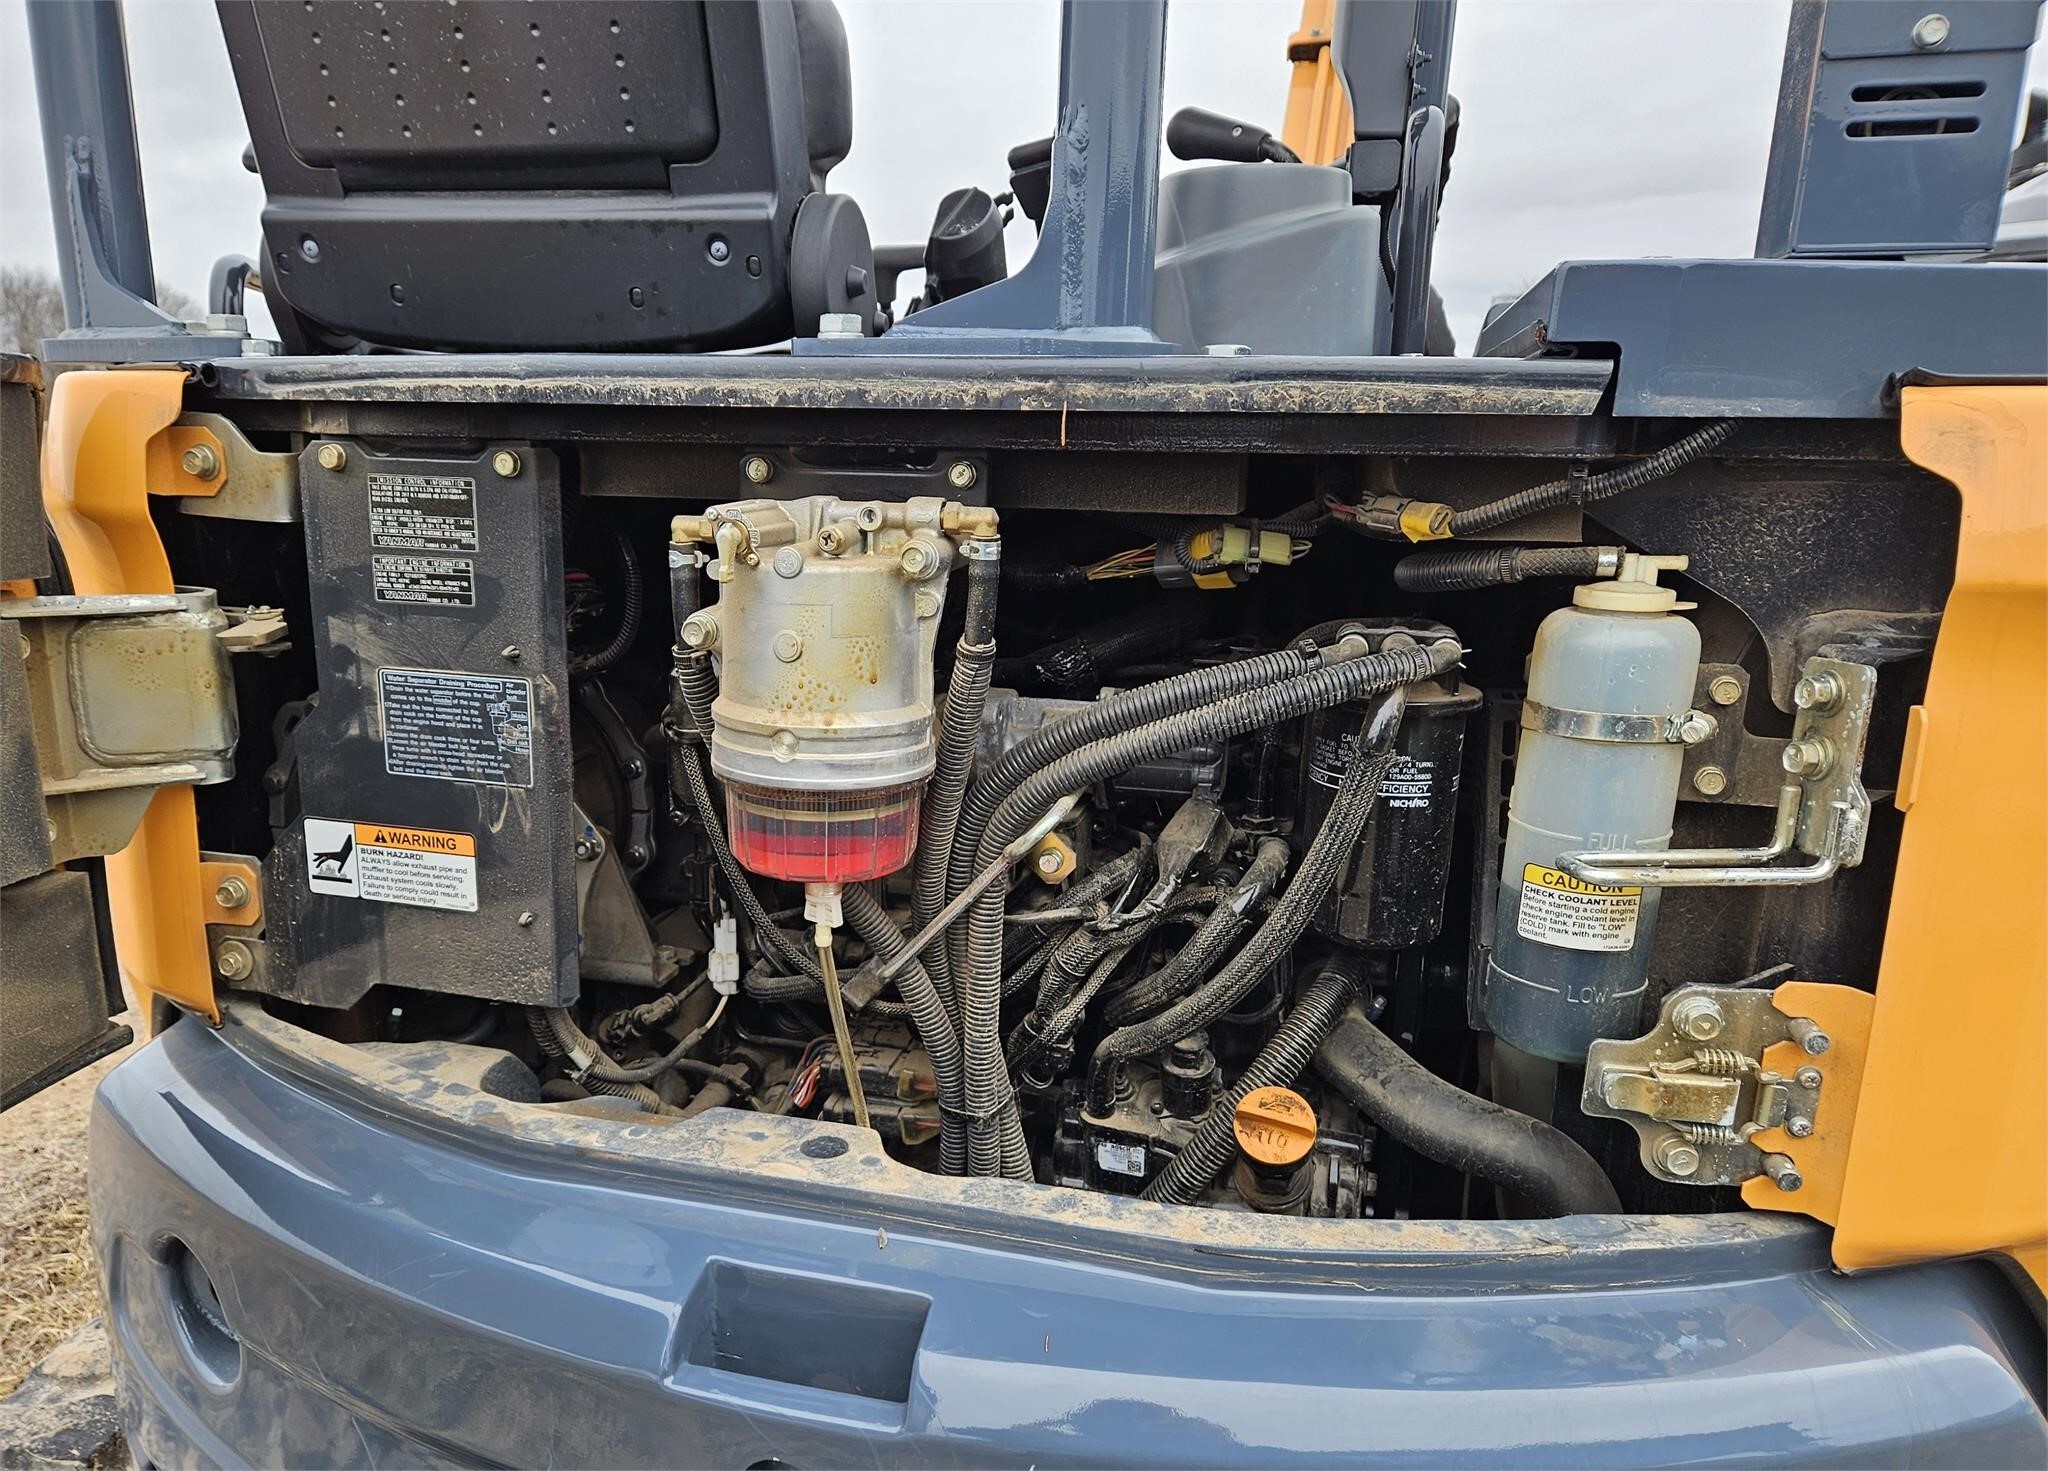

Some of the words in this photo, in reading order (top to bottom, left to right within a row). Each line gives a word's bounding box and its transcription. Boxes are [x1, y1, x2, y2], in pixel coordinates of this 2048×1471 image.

[378, 476, 402, 484] EMISSION
[404, 477, 426, 486] CONTROL
[430, 479, 464, 487] INFORMATION
[378, 535, 424, 547] YANMAR
[383, 590, 427, 600] YANMAR
[387, 675, 405, 683] Water
[407, 676, 437, 686] Separator
[439, 679, 465, 688] Draining
[467, 681, 499, 690] Procedure
[1341, 733, 1360, 743] CAUT
[1337, 749, 1353, 757] BEFO
[1389, 798, 1429, 808] NICHIRO
[388, 831, 456, 850] WARNING
[1590, 832, 1629, 850] FULL
[361, 848, 384, 857] BURN
[387, 851, 423, 860] HAZARD!
[361, 856, 391, 865] ALWAYS
[393, 860, 409, 868] allow
[411, 862, 437, 871] exhaust
[362, 865, 385, 873] muffler
[410, 871, 430, 879] before
[432, 874, 463, 883] servicing.
[362, 873, 388, 882] Exhaust
[391, 877, 414, 885] system
[435, 882, 458, 891] slowly.
[363, 882, 385, 890] Failure
[395, 886, 418, 895] comply
[420, 887, 439, 895] could
[440, 890, 459, 898] result
[1543, 872, 1623, 893] CAUTION
[364, 890, 382, 898] death
[392, 893, 416, 902] serious
[418, 896, 438, 905] injury.
[1524, 893, 1546, 905] Before
[1548, 900, 1580, 912] starting
[1525, 885, 1555, 899] CHECK
[1558, 894, 1608, 906] COOLANT
[1521, 911, 1547, 922] reserve
[1550, 918, 1570, 928] tank.
[1573, 921, 1585, 929] Fill
[1522, 902, 1542, 912] check
[1545, 909, 1573, 920] engine
[1576, 914, 1607, 922] coolant
[1520, 918, 1547, 932] (COLD)
[1549, 925, 1569, 934] mark
[1592, 932, 1619, 940] engine
[1520, 927, 1547, 939] coolant.
[1567, 985, 1609, 1003] LOW
